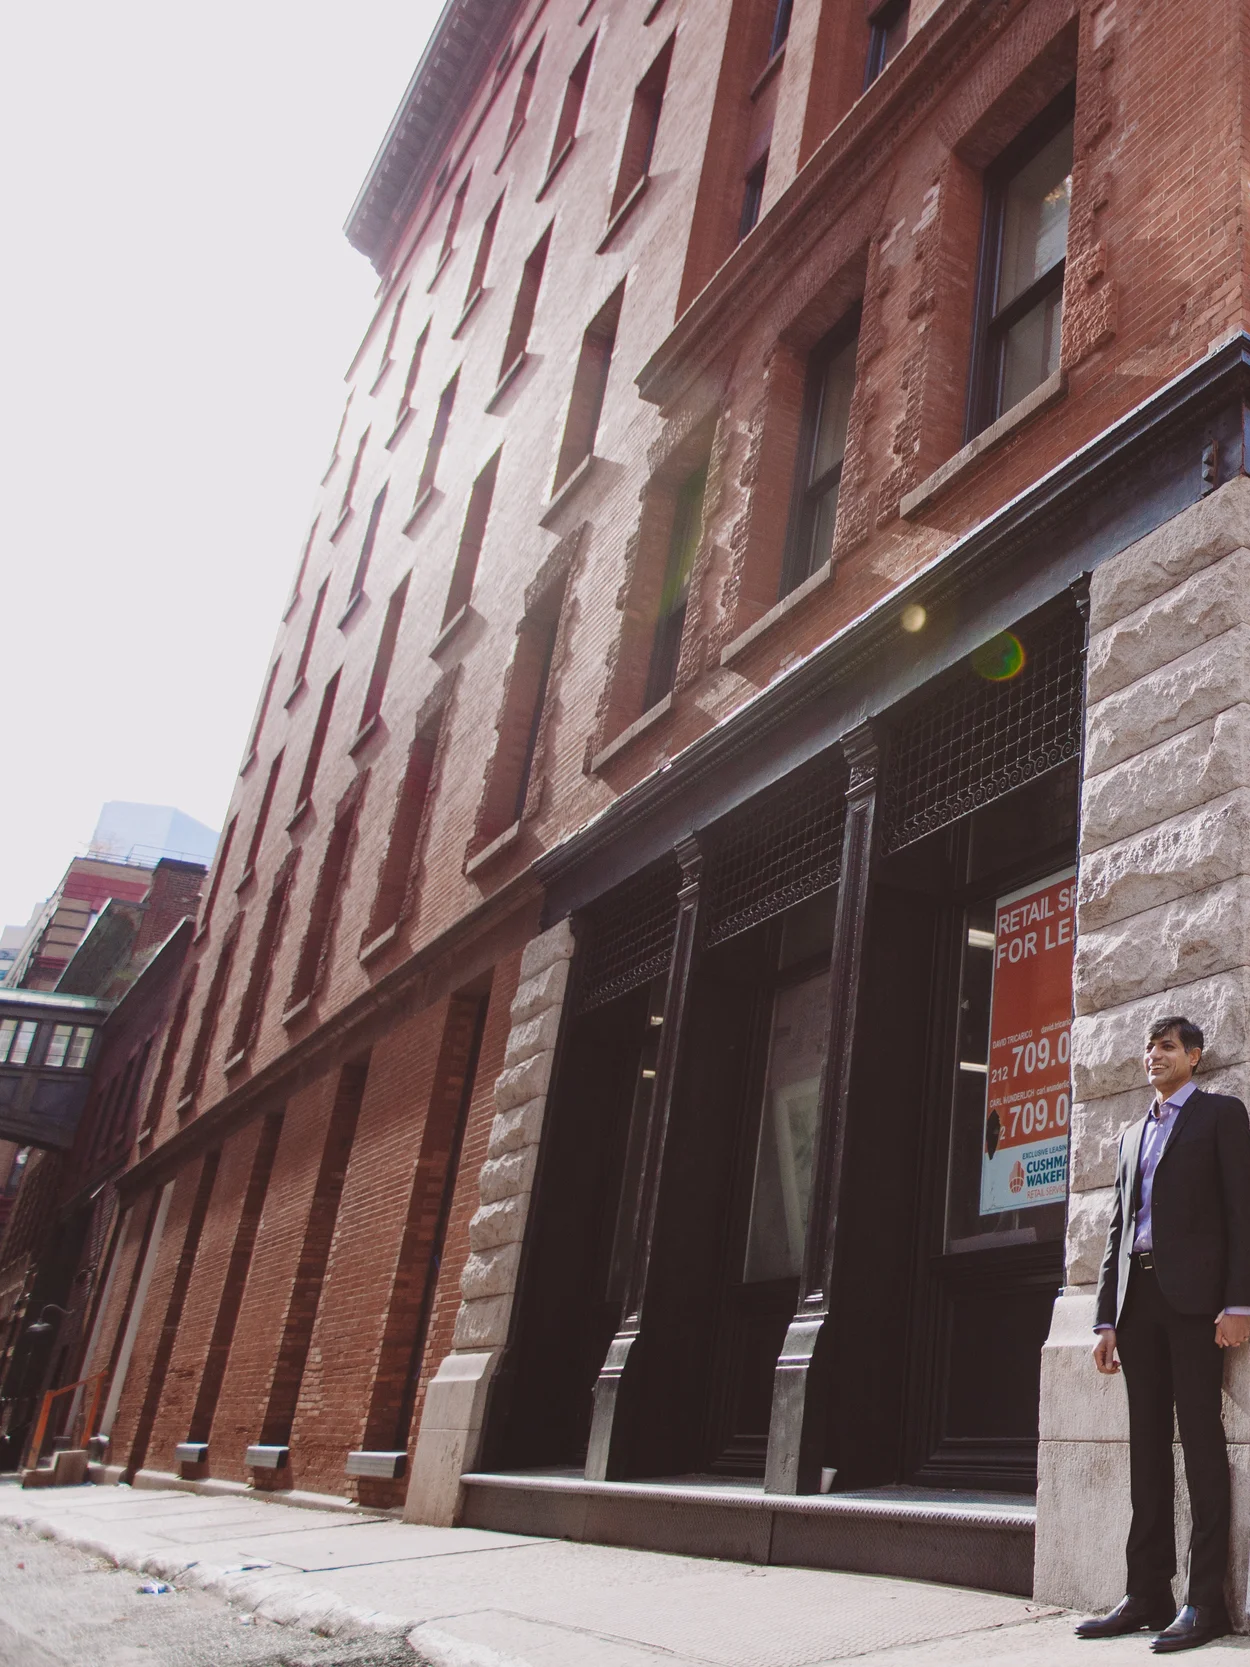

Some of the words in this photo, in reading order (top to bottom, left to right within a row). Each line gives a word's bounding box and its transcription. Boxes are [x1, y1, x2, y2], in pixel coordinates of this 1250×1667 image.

[998, 896, 1055, 937] RETAIL
[997, 931, 1037, 969] FOR
[1045, 917, 1075, 951] LE
[992, 1037, 1007, 1049] DAVID
[991, 1065, 1009, 1084] 212
[1022, 1147, 1048, 1160] EXCLUSIVE
[1026, 1187, 1045, 1199] RETAIL
